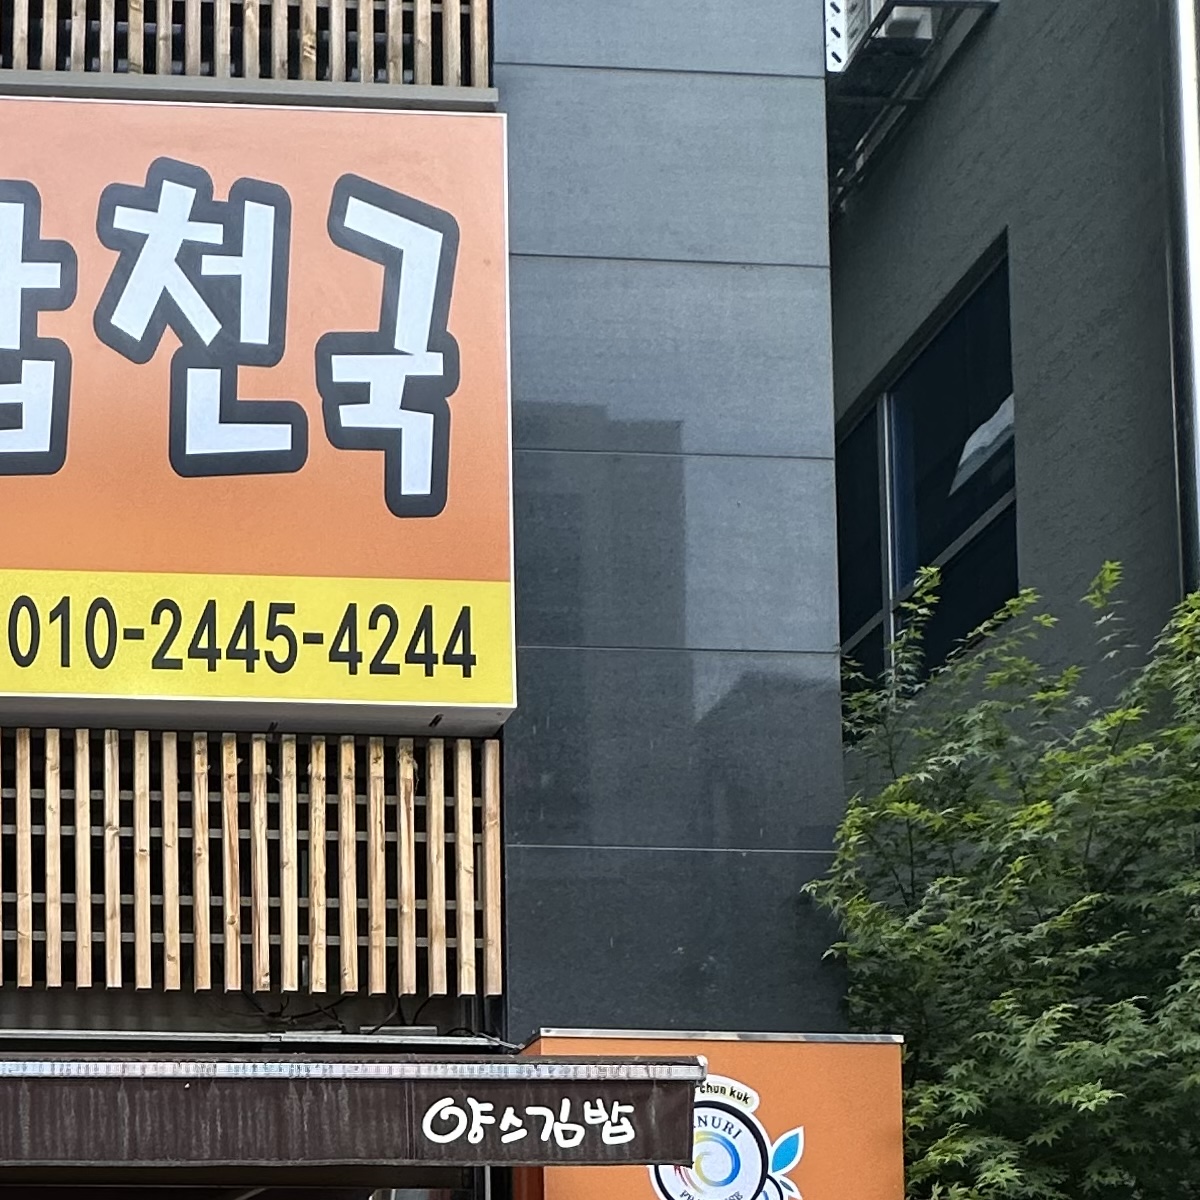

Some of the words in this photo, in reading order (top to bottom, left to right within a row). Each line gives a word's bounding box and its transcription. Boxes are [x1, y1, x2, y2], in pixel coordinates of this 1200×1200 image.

[7, 595, 477, 679] 010-2445-4244
[729, 1086, 751, 1105] kuk
[421, 1096, 635, 1149] 양스김밥
[693, 1114, 743, 1141] NURI
